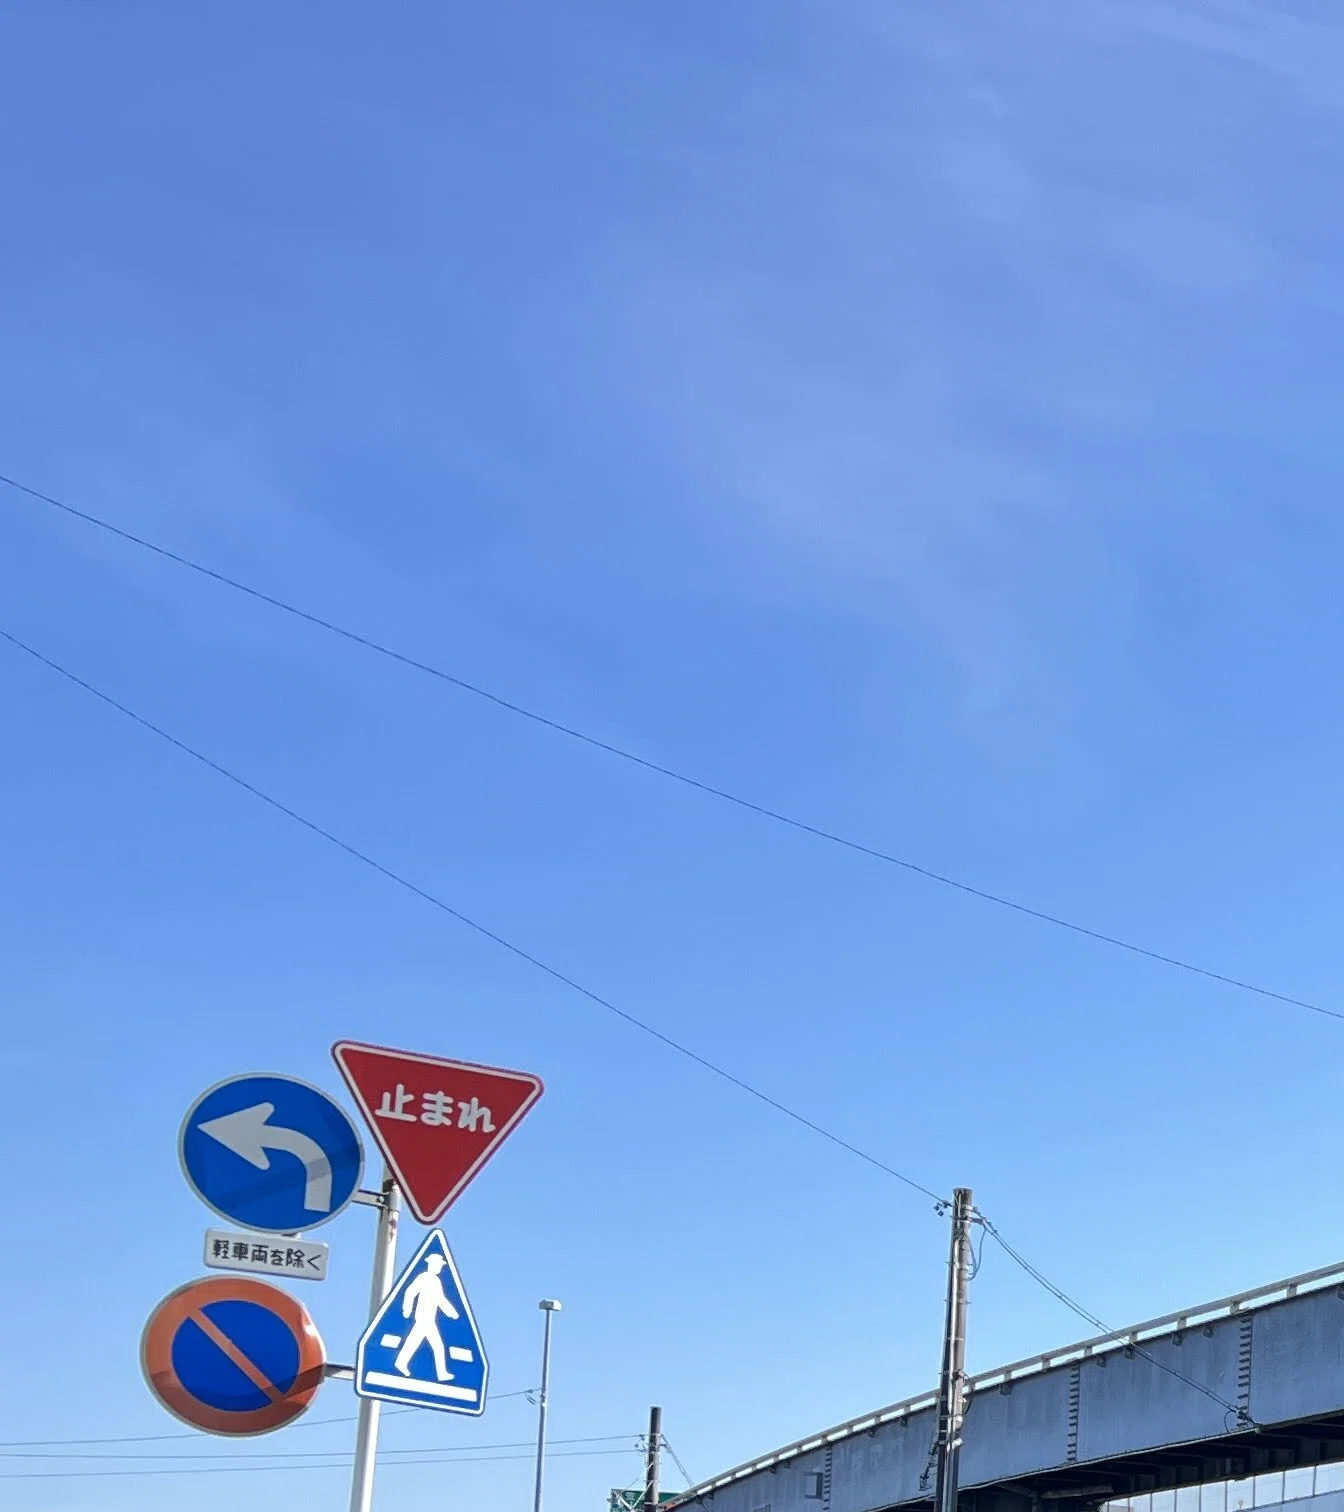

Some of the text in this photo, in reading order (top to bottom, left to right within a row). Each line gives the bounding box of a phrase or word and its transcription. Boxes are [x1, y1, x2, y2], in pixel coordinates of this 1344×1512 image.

[375, 1083, 496, 1133] 止まれ
[212, 1239, 321, 1271] 軽車両を除く
